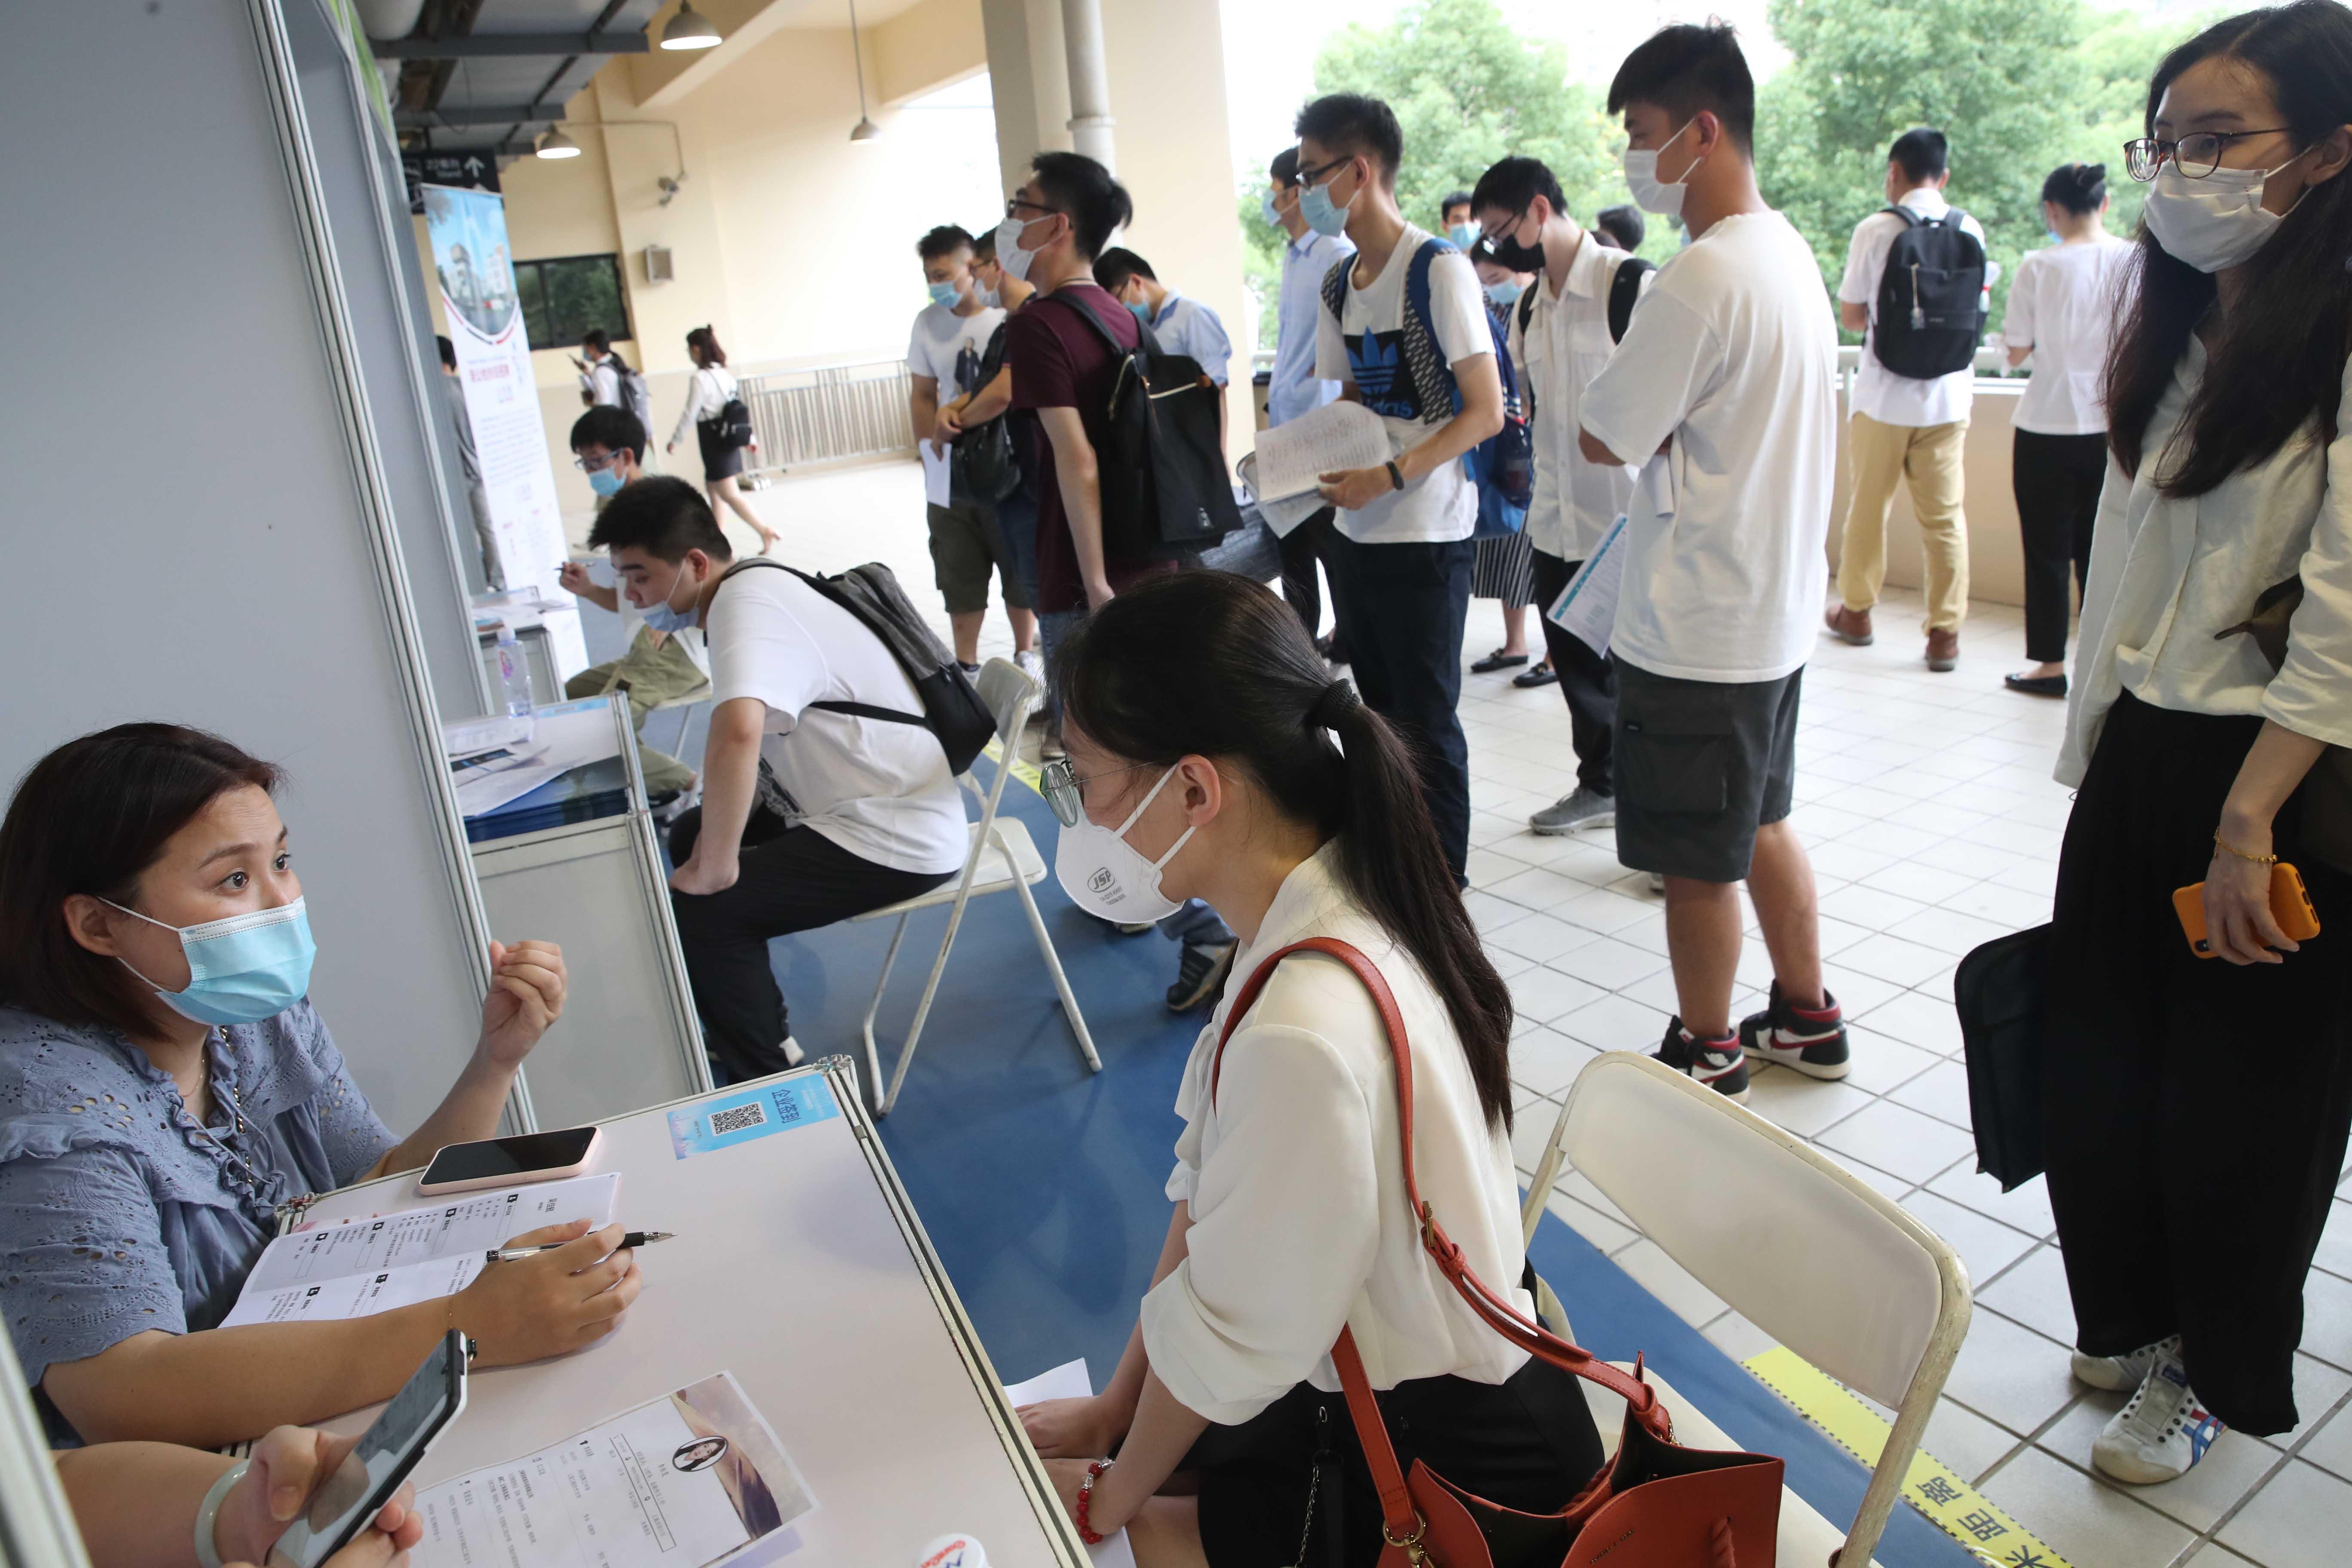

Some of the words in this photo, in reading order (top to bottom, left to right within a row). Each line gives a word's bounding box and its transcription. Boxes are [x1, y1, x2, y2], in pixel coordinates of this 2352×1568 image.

[1094, 870, 1111, 889] JSP
[772, 1090, 802, 1123] 企业签到
[1915, 1476, 2051, 1568] 米距离
